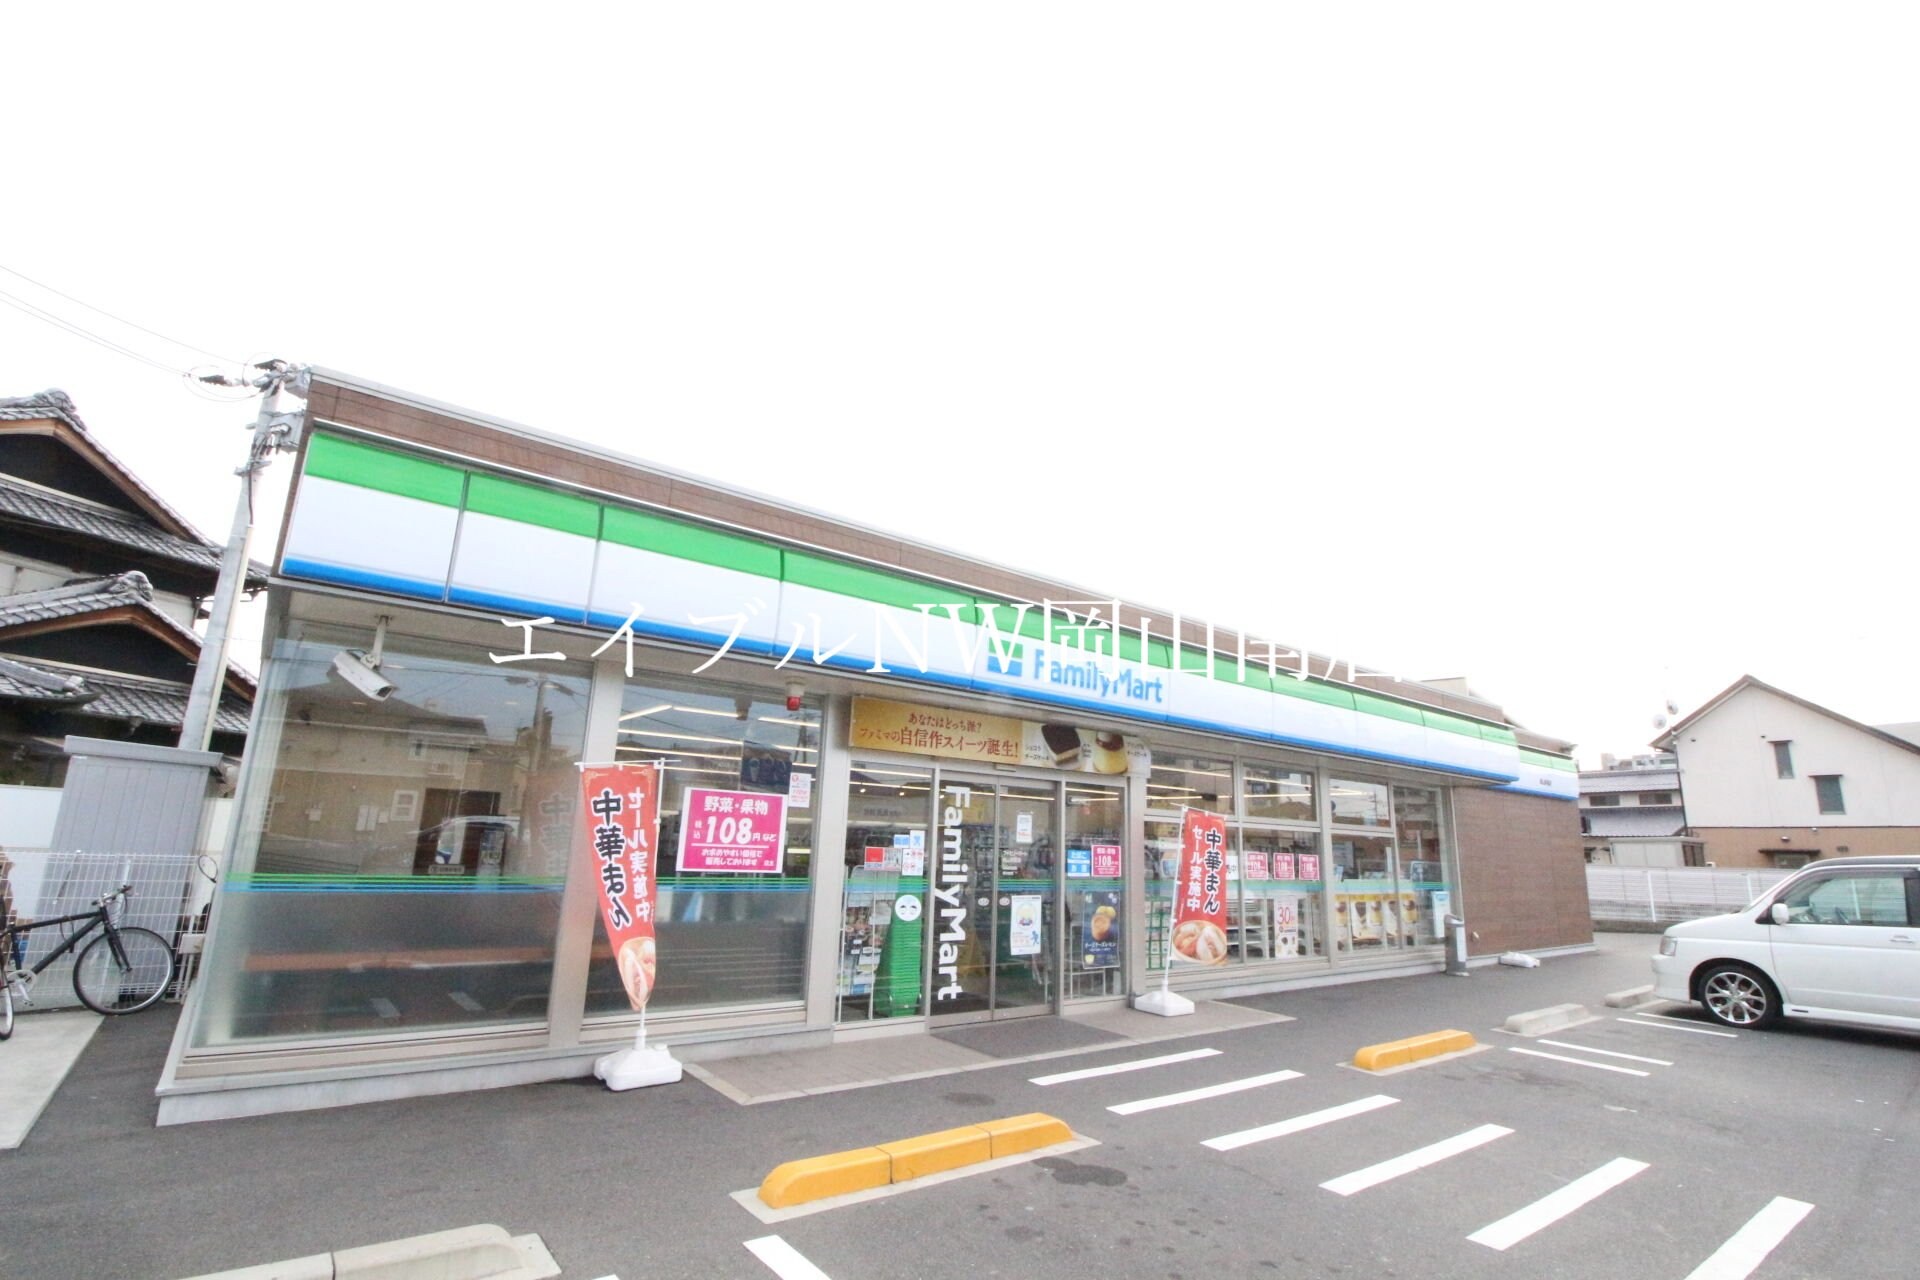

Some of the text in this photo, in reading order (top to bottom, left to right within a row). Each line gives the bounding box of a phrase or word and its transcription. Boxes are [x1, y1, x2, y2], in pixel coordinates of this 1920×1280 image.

[1034, 648, 1163, 703] FamilyMart
[934, 785, 970, 1001] FamilyMart
[1187, 825, 1203, 912] セール実施中
[1204, 828, 1223, 915] 中華まん
